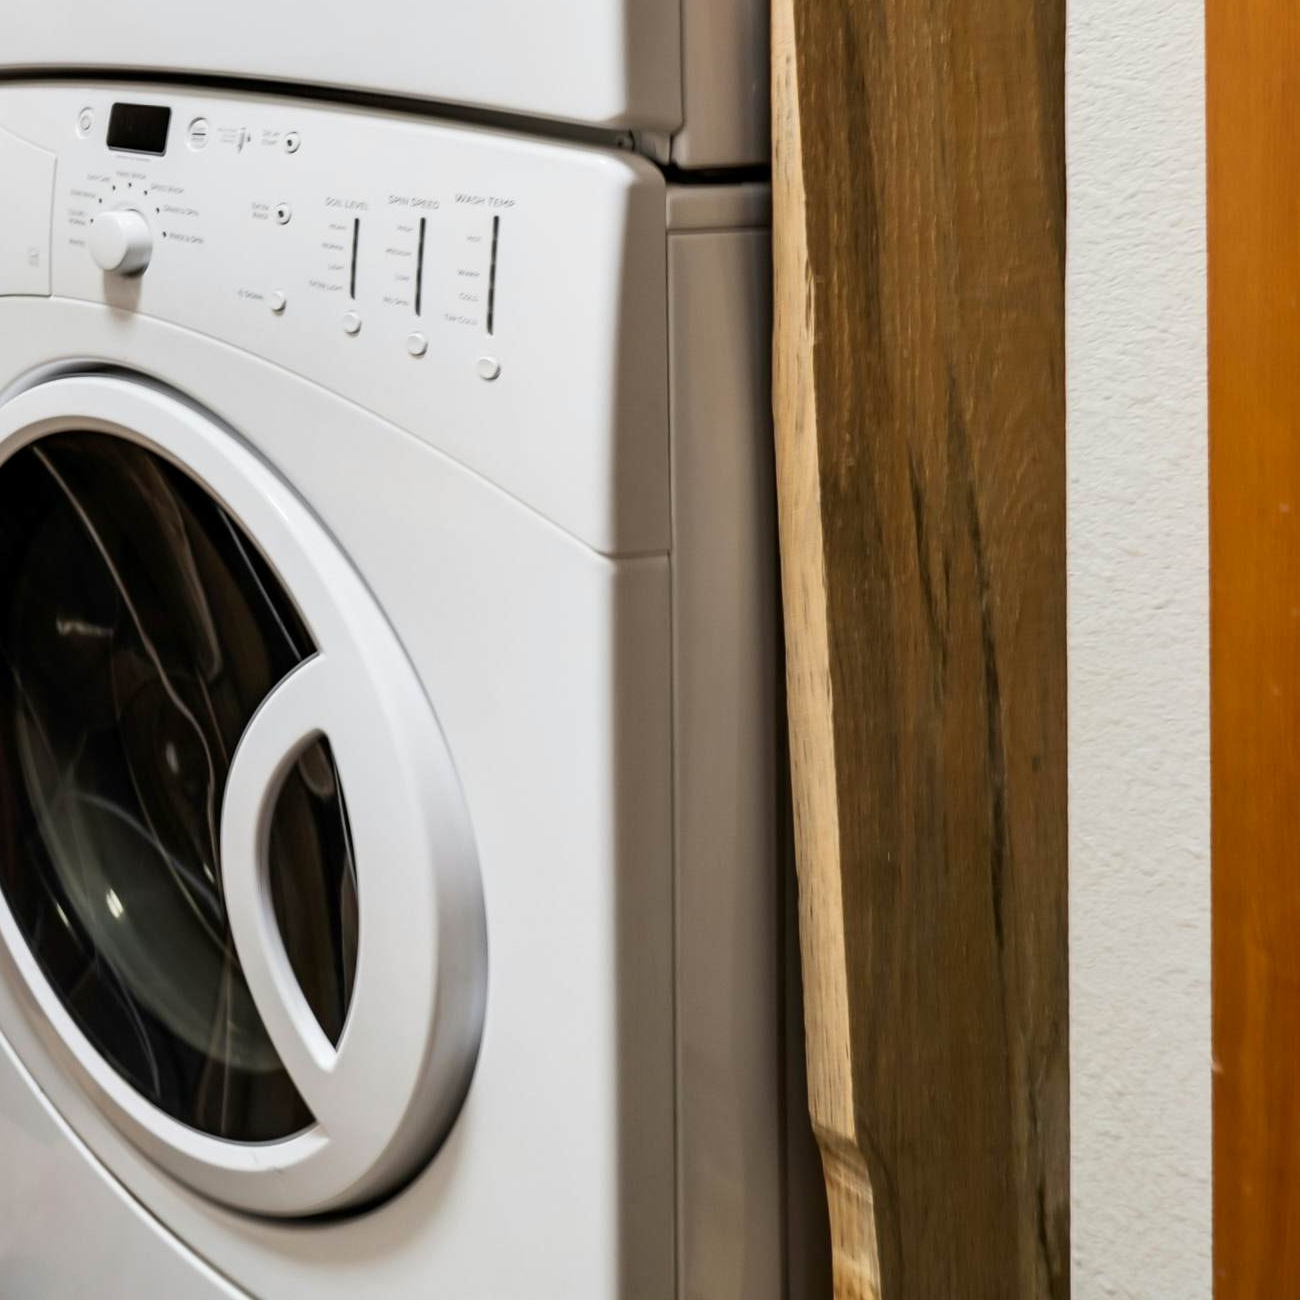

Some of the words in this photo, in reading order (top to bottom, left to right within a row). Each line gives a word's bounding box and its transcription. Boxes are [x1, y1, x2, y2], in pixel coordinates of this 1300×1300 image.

[324, 196, 343, 208] SOIL
[345, 198, 369, 211] LEVEL
[387, 194, 409, 205] SPIN
[410, 197, 440, 211] SPEED
[454, 193, 485, 205] WASH
[487, 195, 517, 208] TEMP
